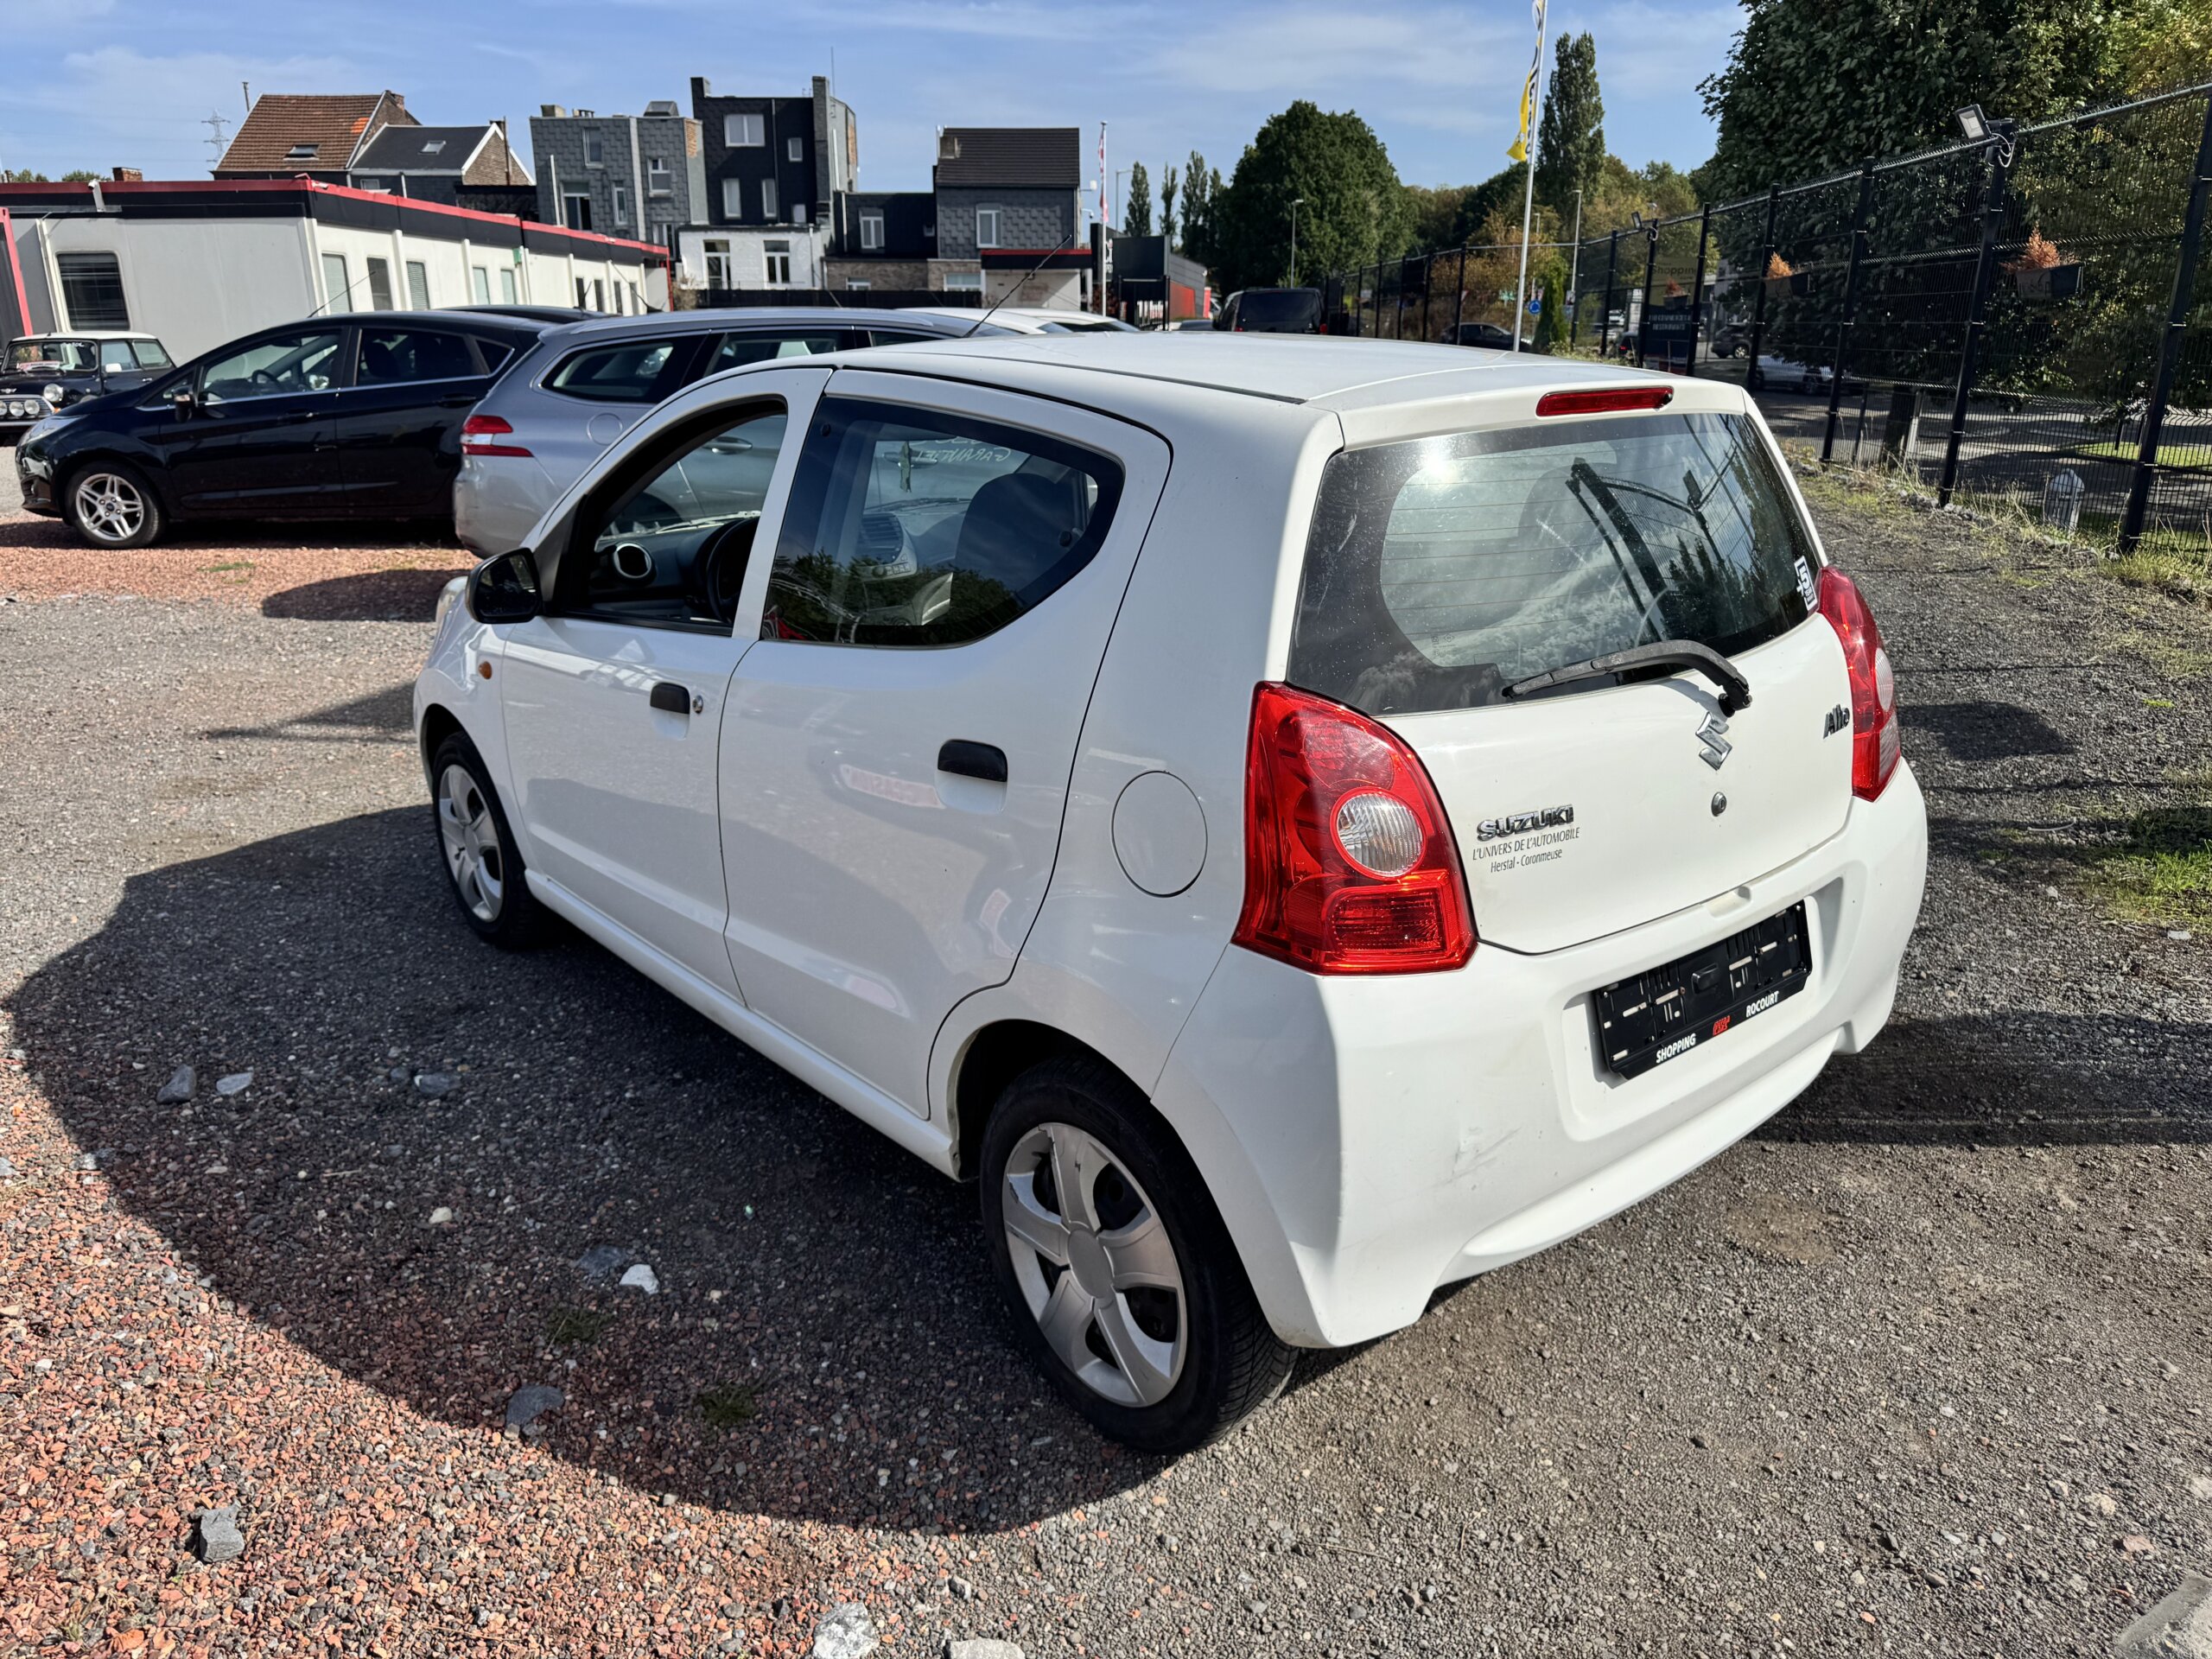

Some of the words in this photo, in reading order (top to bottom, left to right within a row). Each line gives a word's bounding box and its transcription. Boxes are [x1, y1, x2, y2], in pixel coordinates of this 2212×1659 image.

[1652, 265, 1696, 276] Shoppin
[1477, 804, 1574, 842] SUZUKI
[1472, 841, 1512, 861] L'UNIVERS
[1514, 838, 1526, 852] DE
[1527, 827, 1580, 849] L'AUTOMOBILE
[1491, 856, 1516, 873] Herstal
[1521, 849, 1563, 867] Coronmeuse
[1656, 1033, 1696, 1064] SHOPPING
[1746, 990, 1780, 1018] ROCOURT
